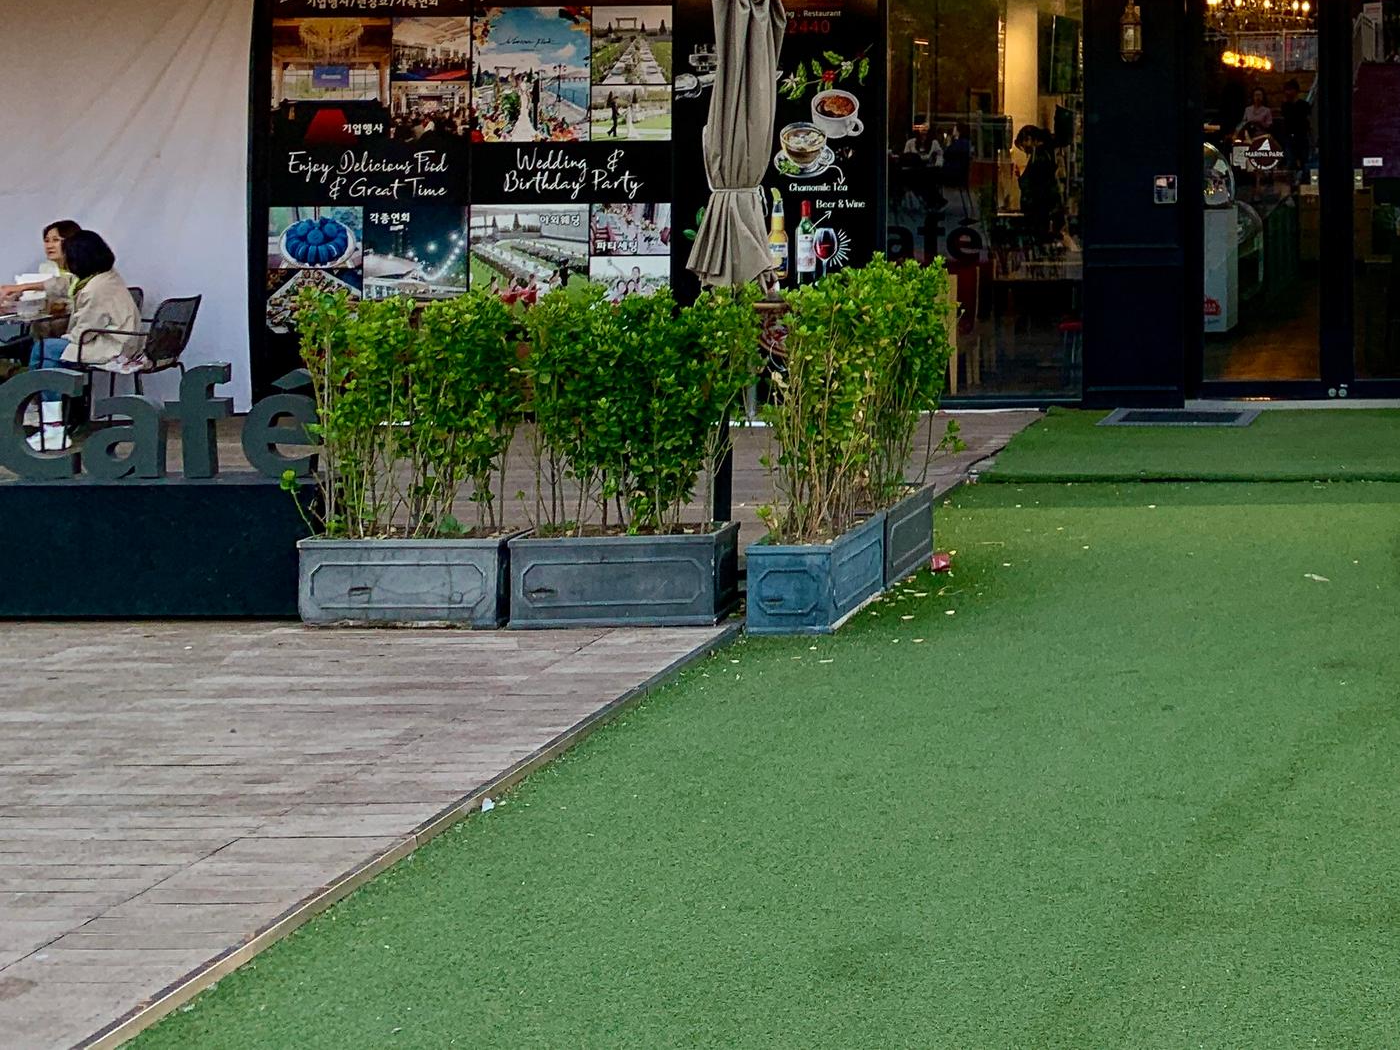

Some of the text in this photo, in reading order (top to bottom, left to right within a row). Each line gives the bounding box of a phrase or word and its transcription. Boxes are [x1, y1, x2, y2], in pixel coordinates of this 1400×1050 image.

[342, 123, 384, 135] 기업행사
[288, 150, 335, 184] Enjoy
[336, 149, 414, 175] Delicious
[516, 147, 625, 182] Wedding &
[348, 177, 407, 200] Great
[404, 176, 448, 198] Time
[503, 168, 645, 200] Birthday Party
[788, 182, 848, 192] Chamomile Tea
[815, 199, 836, 209] Beer
[845, 199, 866, 209] Wine
